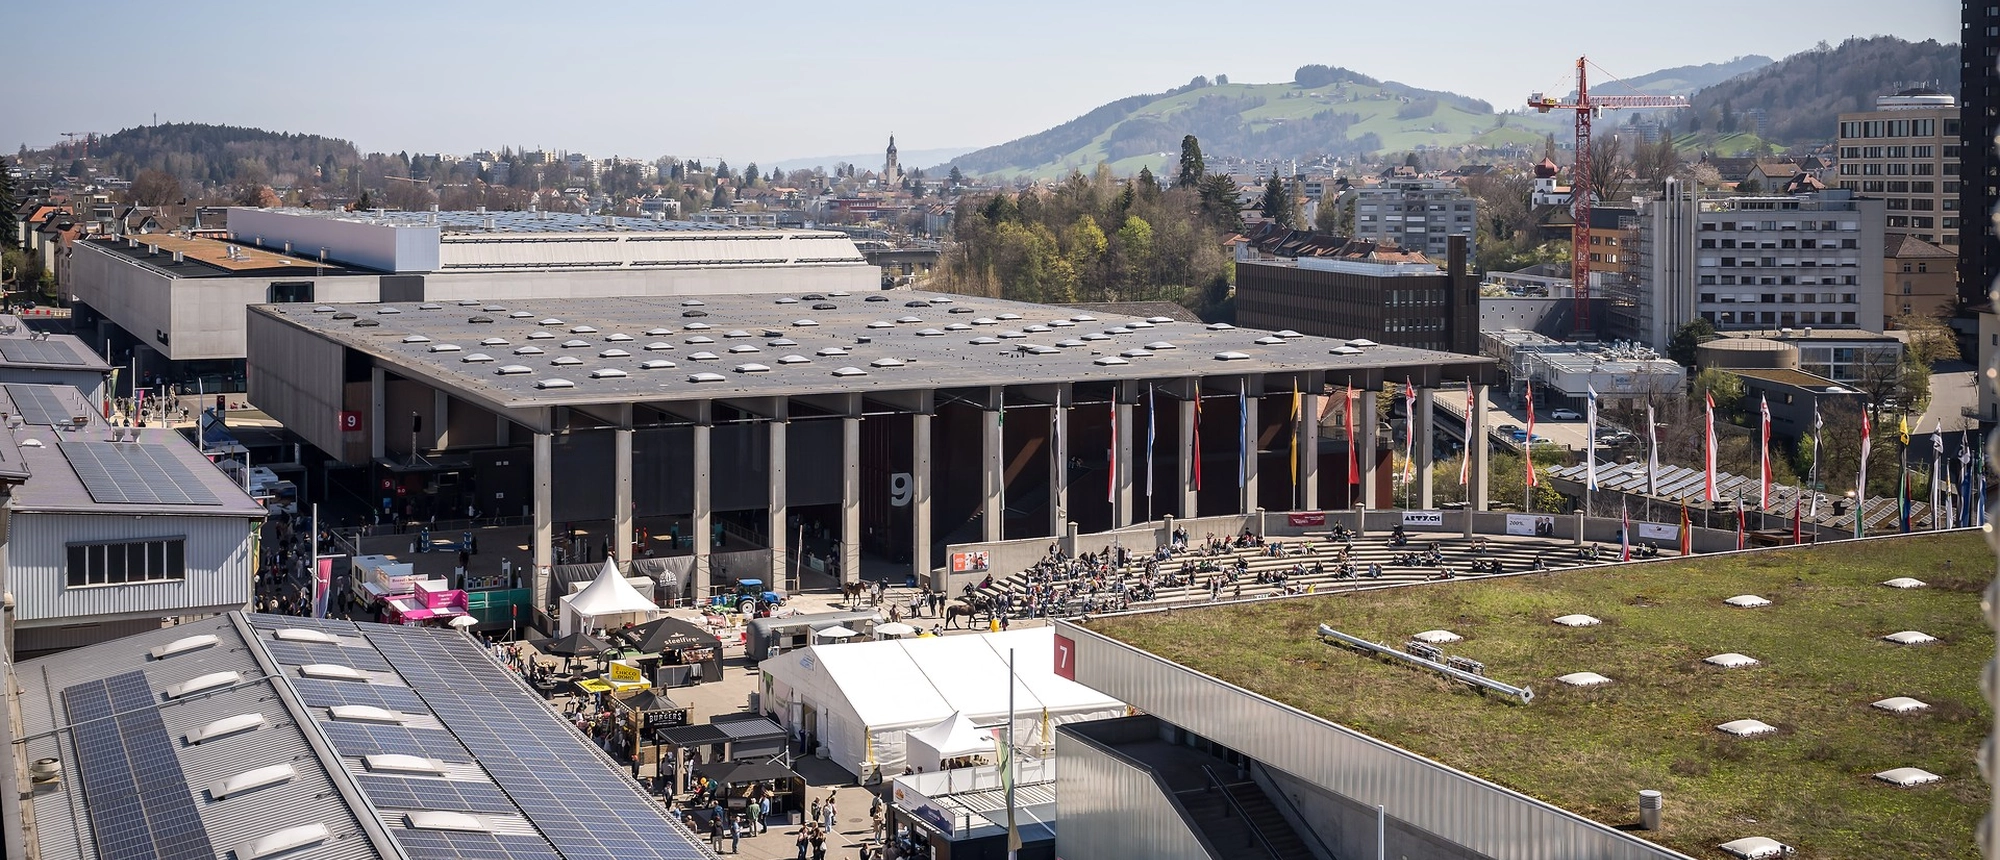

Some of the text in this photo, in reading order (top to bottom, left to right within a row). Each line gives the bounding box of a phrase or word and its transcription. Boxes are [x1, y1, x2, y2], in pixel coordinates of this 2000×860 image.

[347, 415, 356, 427] 9
[384, 480, 391, 488] 9
[891, 472, 913, 507] 9
[664, 637, 697, 645] steelfire
[1059, 645, 1068, 669] 7
[649, 712, 682, 723] BURGERS
